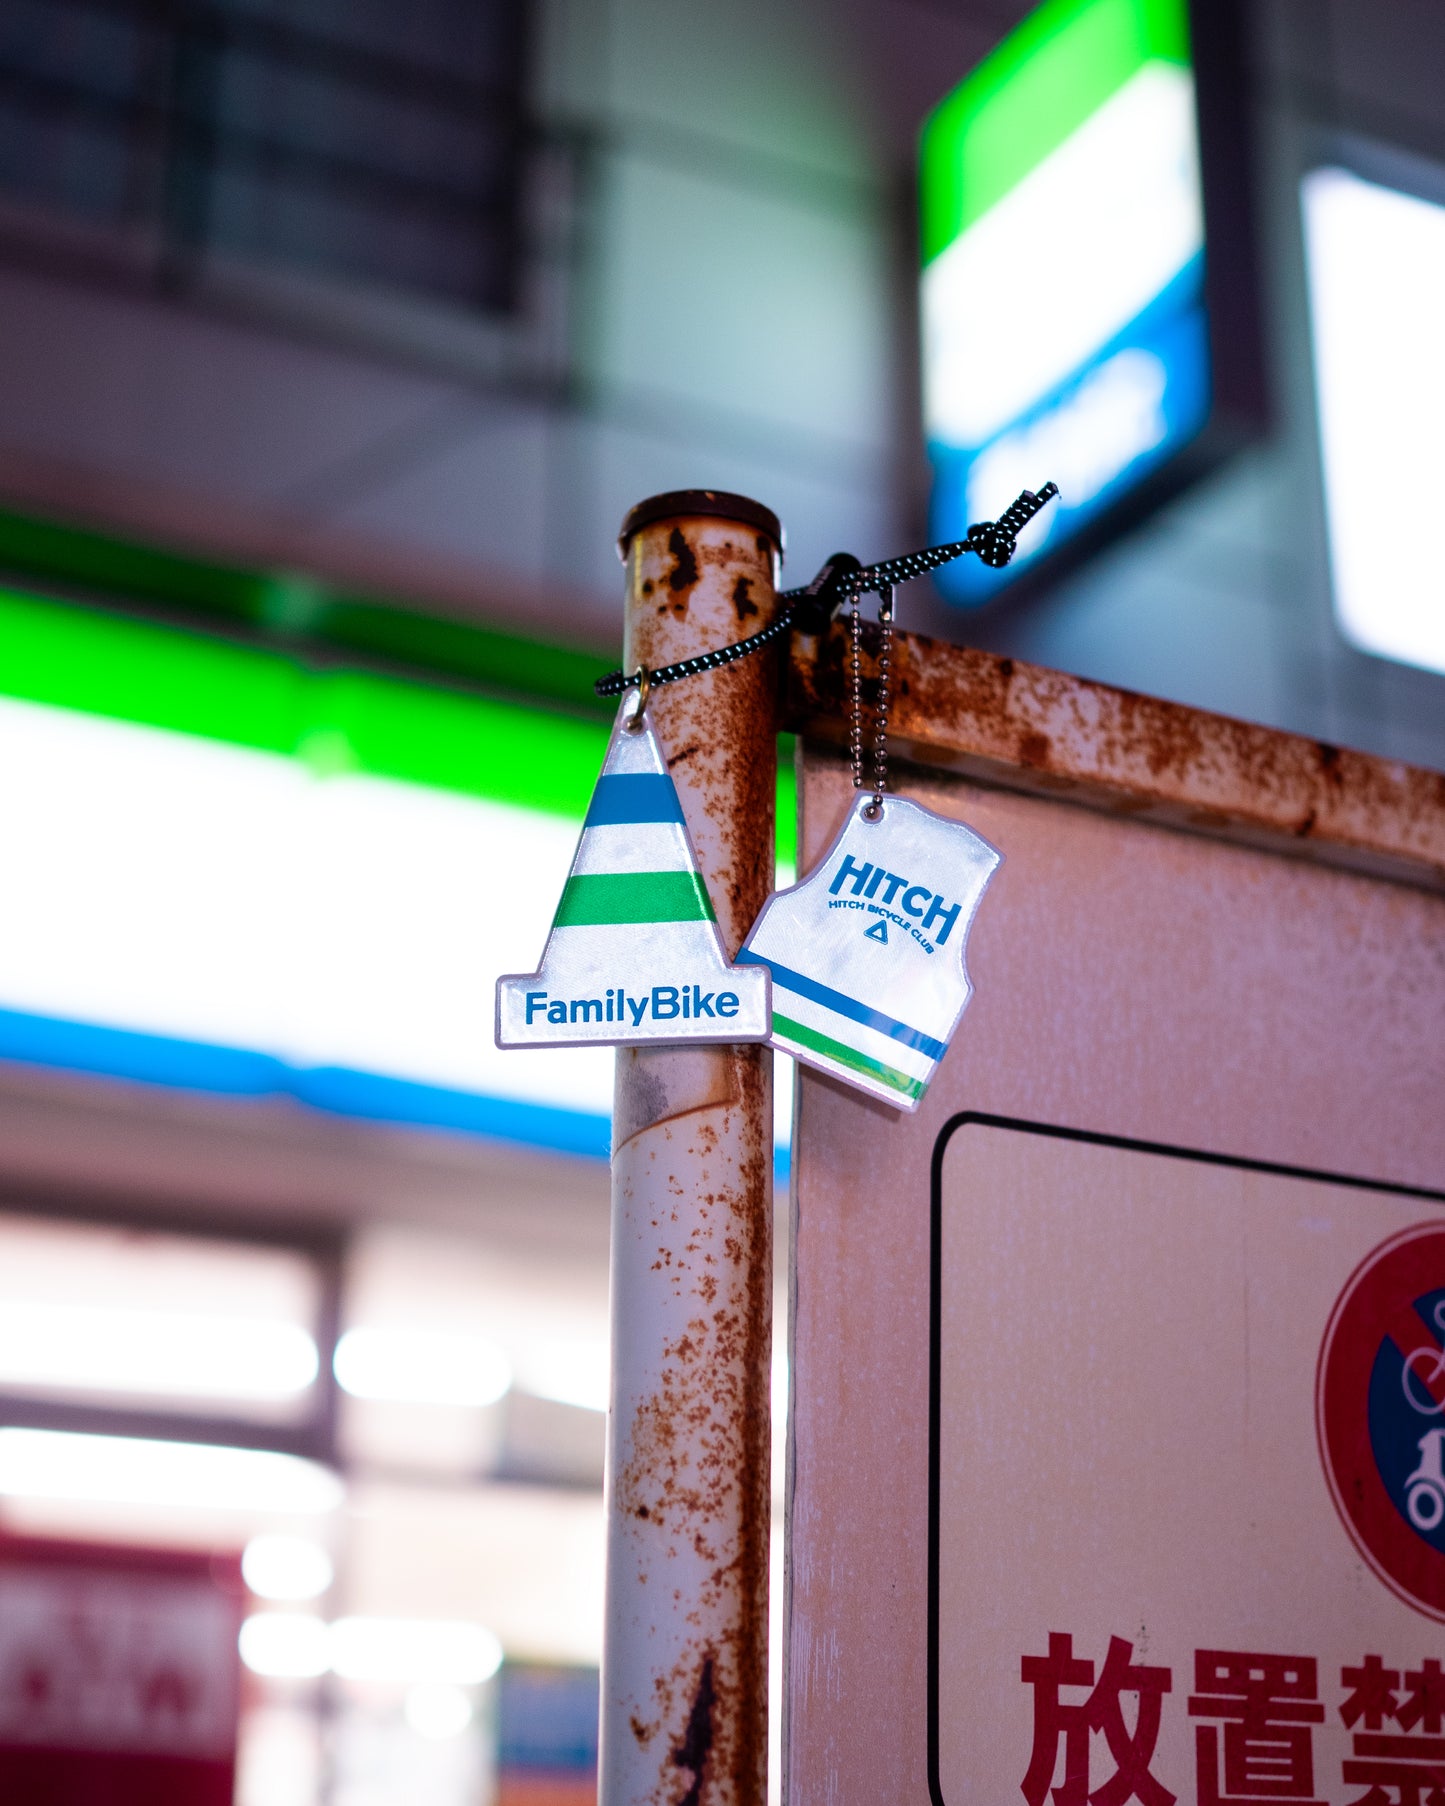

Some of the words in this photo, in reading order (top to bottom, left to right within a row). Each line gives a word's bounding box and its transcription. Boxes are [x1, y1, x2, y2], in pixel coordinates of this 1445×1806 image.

[828, 854, 963, 946] HITCH
[828, 900, 866, 911] HITCH
[867, 904, 912, 931] BICYCLE
[910, 928, 935, 955] CLUB
[525, 984, 740, 1027] FamilyBike
